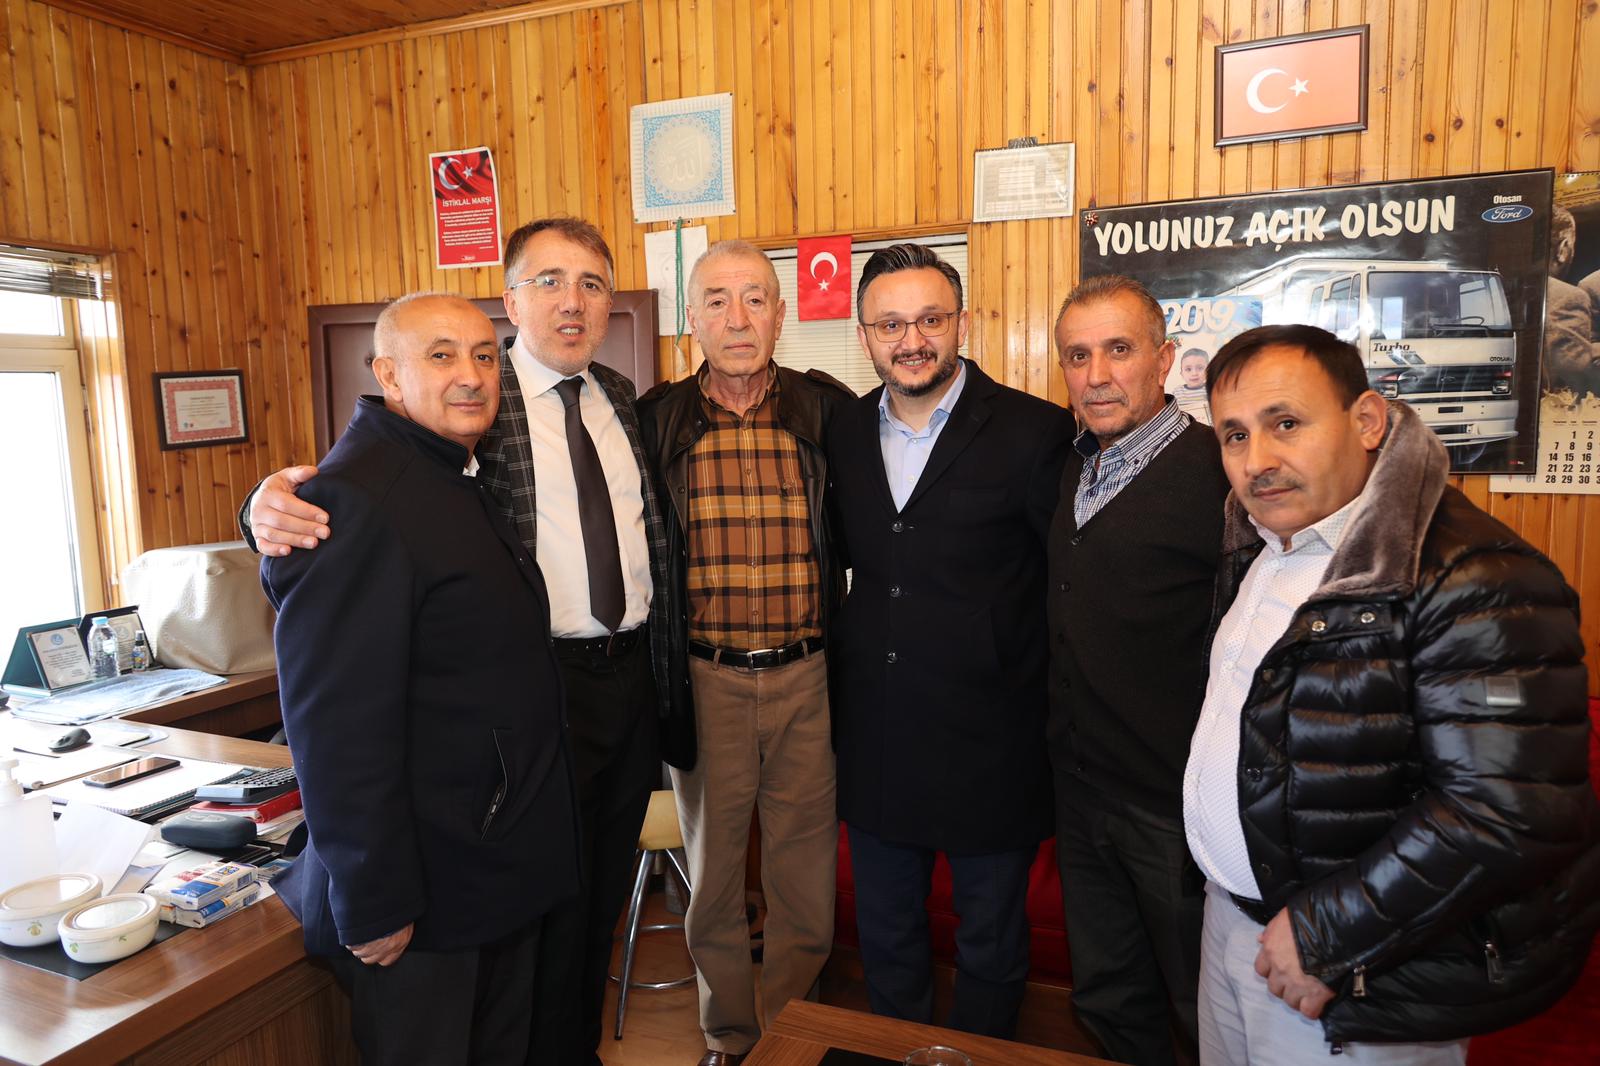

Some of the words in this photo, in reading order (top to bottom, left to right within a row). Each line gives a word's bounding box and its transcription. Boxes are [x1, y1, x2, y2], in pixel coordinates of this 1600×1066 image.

[443, 198, 471, 207] İSTİKLAL
[472, 196, 492, 205] MARŞI
[1493, 195, 1522, 204] Otosan
[1491, 207, 1523, 220] Ford
[1094, 216, 1235, 256] YOLUNUZ
[1246, 206, 1327, 252] AÇIK
[1340, 195, 1456, 239] OLSUN
[1163, 300, 1234, 333] 2019
[1373, 342, 1410, 352] Turbo
[1572, 431, 1576, 439] 1
[1588, 431, 1593, 439] 2
[1555, 442, 1559, 450] 7
[1570, 442, 1575, 450] 8
[1587, 442, 1592, 450] 9
[1549, 453, 1558, 461] 14
[1565, 453, 1574, 461] 15
[1582, 453, 1591, 461] 16
[1548, 464, 1557, 472] 21
[1563, 464, 1573, 472] 22
[1580, 464, 1590, 472] 23
[1545, 475, 1556, 483] 28
[1562, 475, 1572, 483] 29
[1579, 475, 1589, 484] 30
